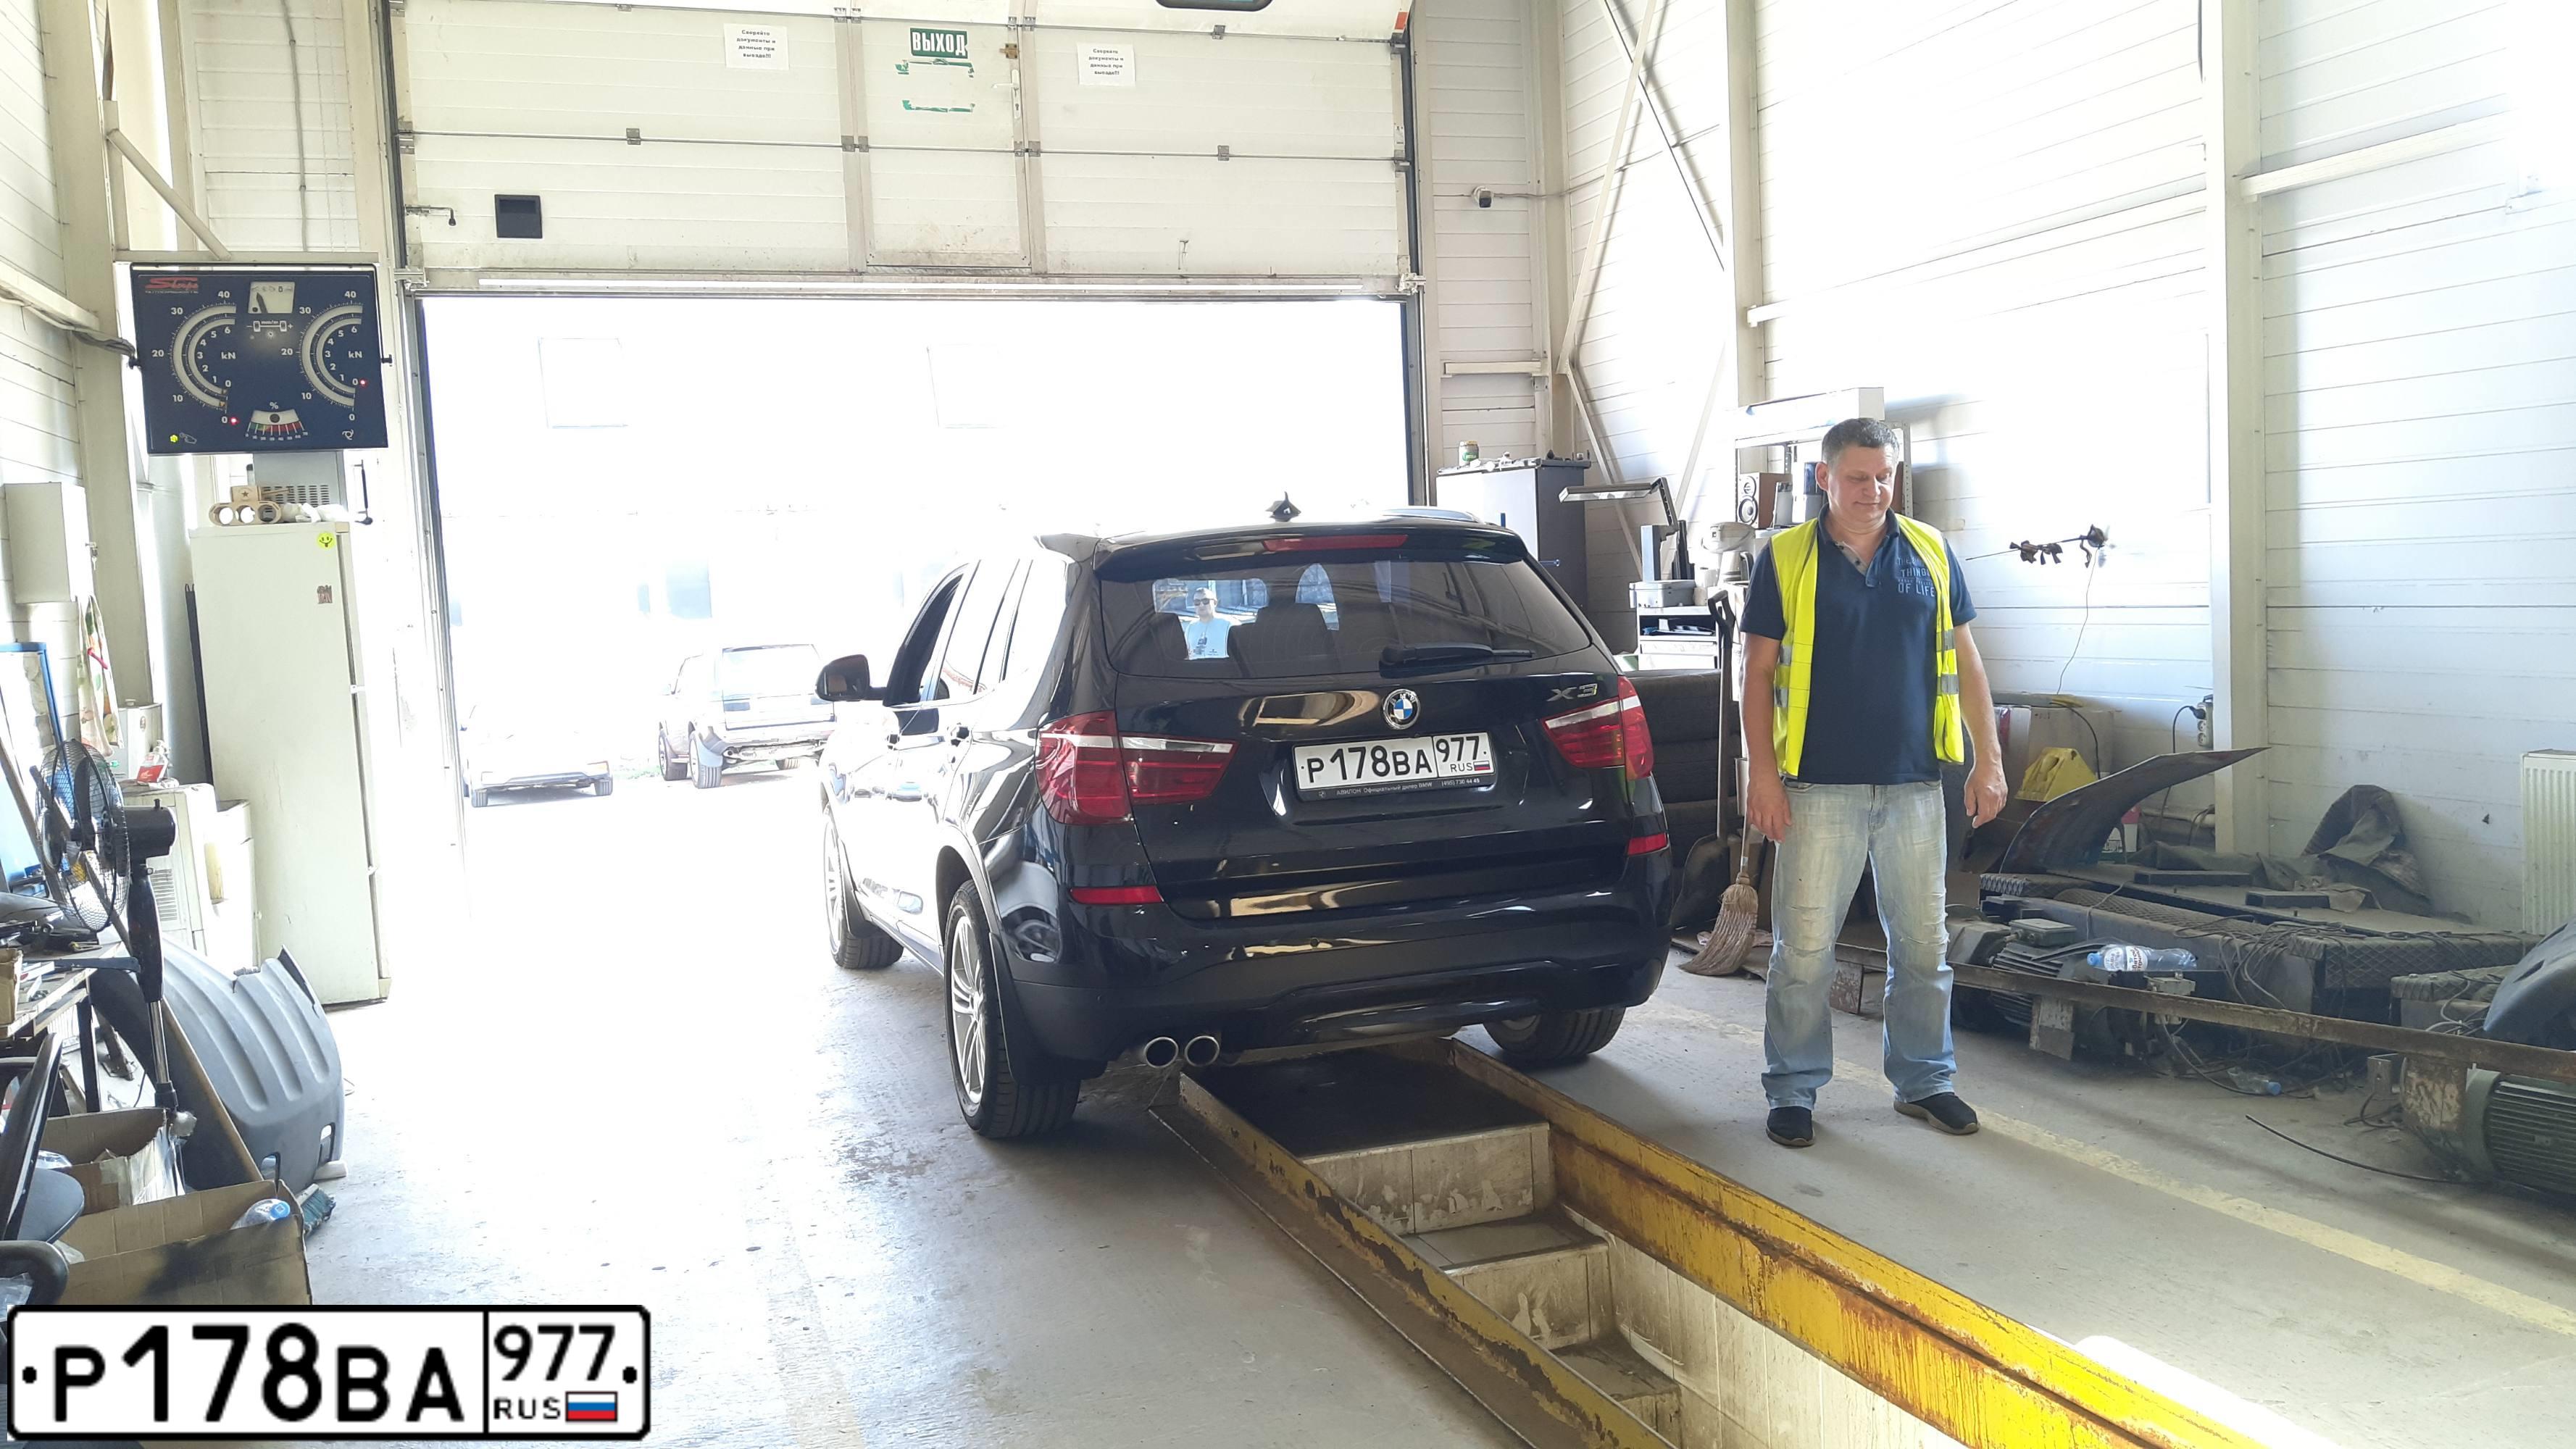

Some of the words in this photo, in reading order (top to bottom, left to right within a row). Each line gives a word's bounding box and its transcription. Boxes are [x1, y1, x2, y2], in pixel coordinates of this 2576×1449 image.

[912, 31, 966, 56] ВЫХОД
[221, 351, 236, 360] kN
[172, 394, 183, 403] 10
[269, 401, 279, 410] %
[1898, 582, 1912, 594] OF
[1916, 582, 1935, 597] LIFE
[1546, 683, 1598, 702] X3
[1435, 736, 1480, 763] 977
[1450, 762, 1473, 772] RUS
